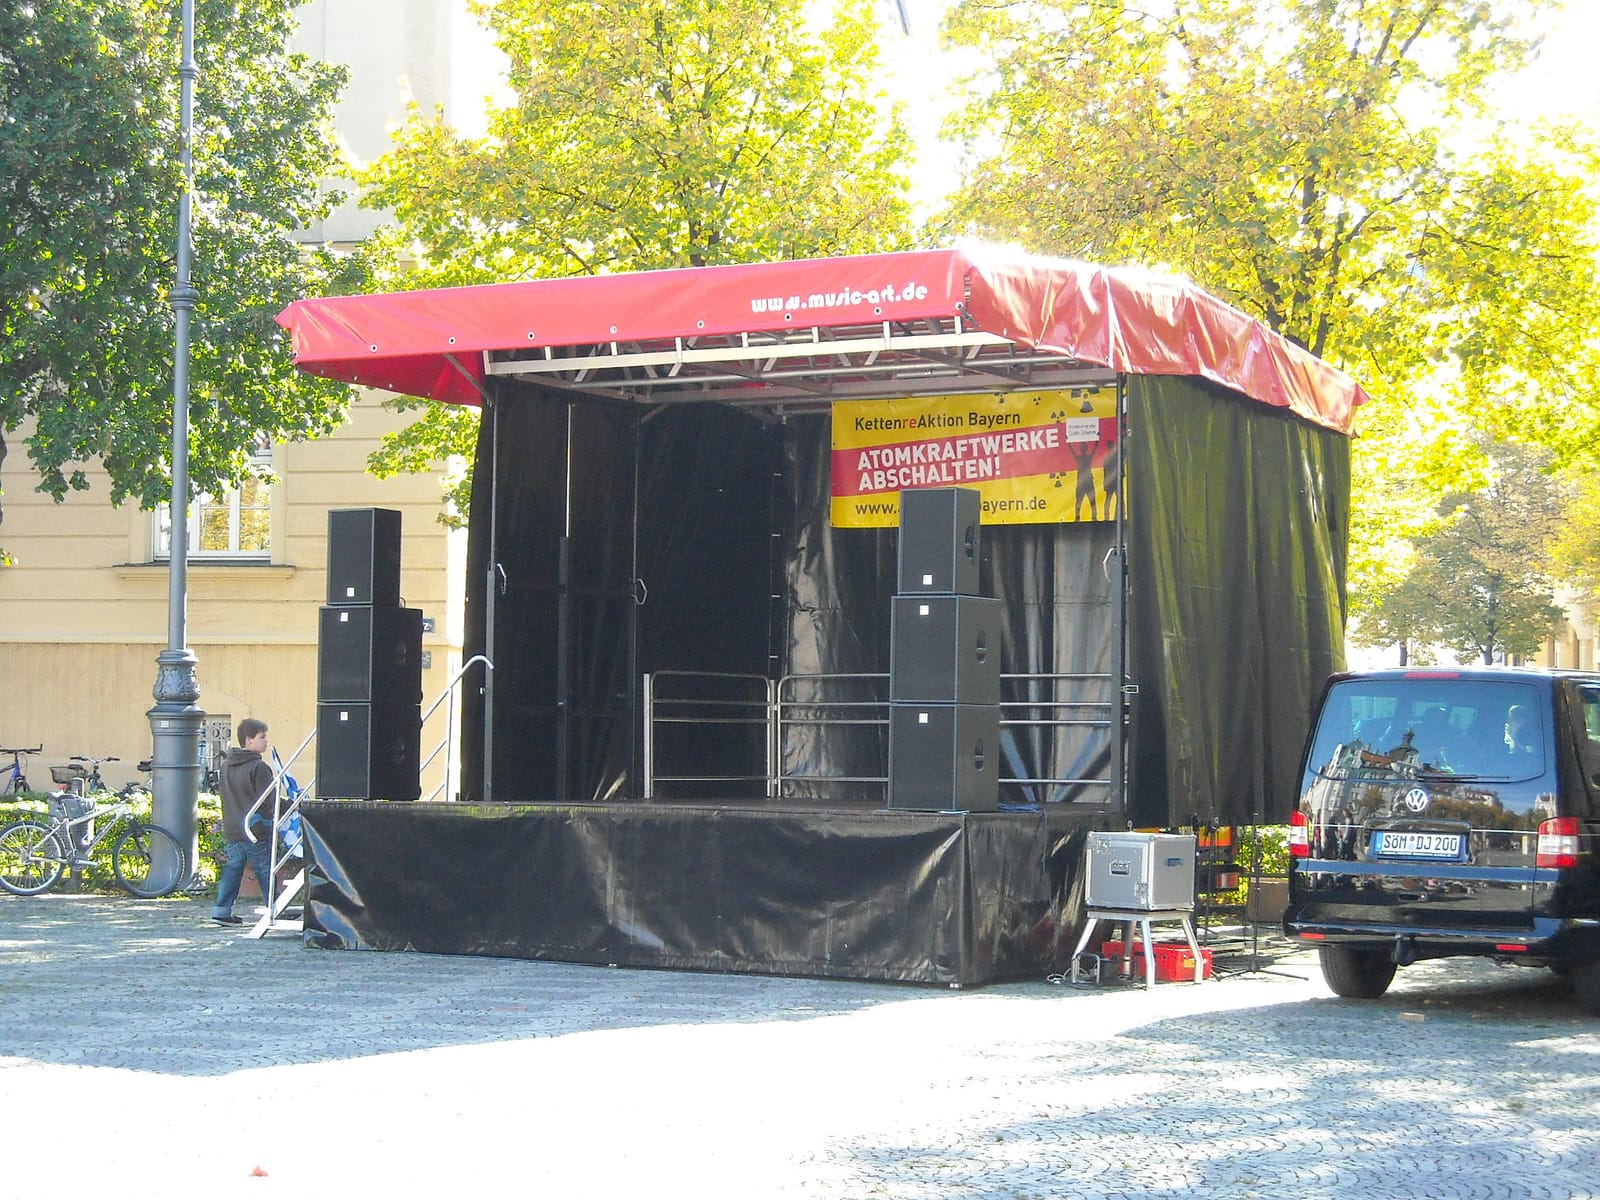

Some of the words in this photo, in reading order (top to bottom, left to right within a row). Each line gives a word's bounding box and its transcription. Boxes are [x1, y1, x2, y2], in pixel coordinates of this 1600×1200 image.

[751, 281, 928, 313] www.music-art.de
[855, 412, 965, 431] KettenreAktion
[969, 412, 1021, 429] Bayern
[857, 428, 1060, 471] ATOMKRAFTWERKE
[858, 455, 1001, 492] ABSCHALTEN!
[1416, 836, 1432, 850] DJ
[1434, 837, 1458, 851] 200
